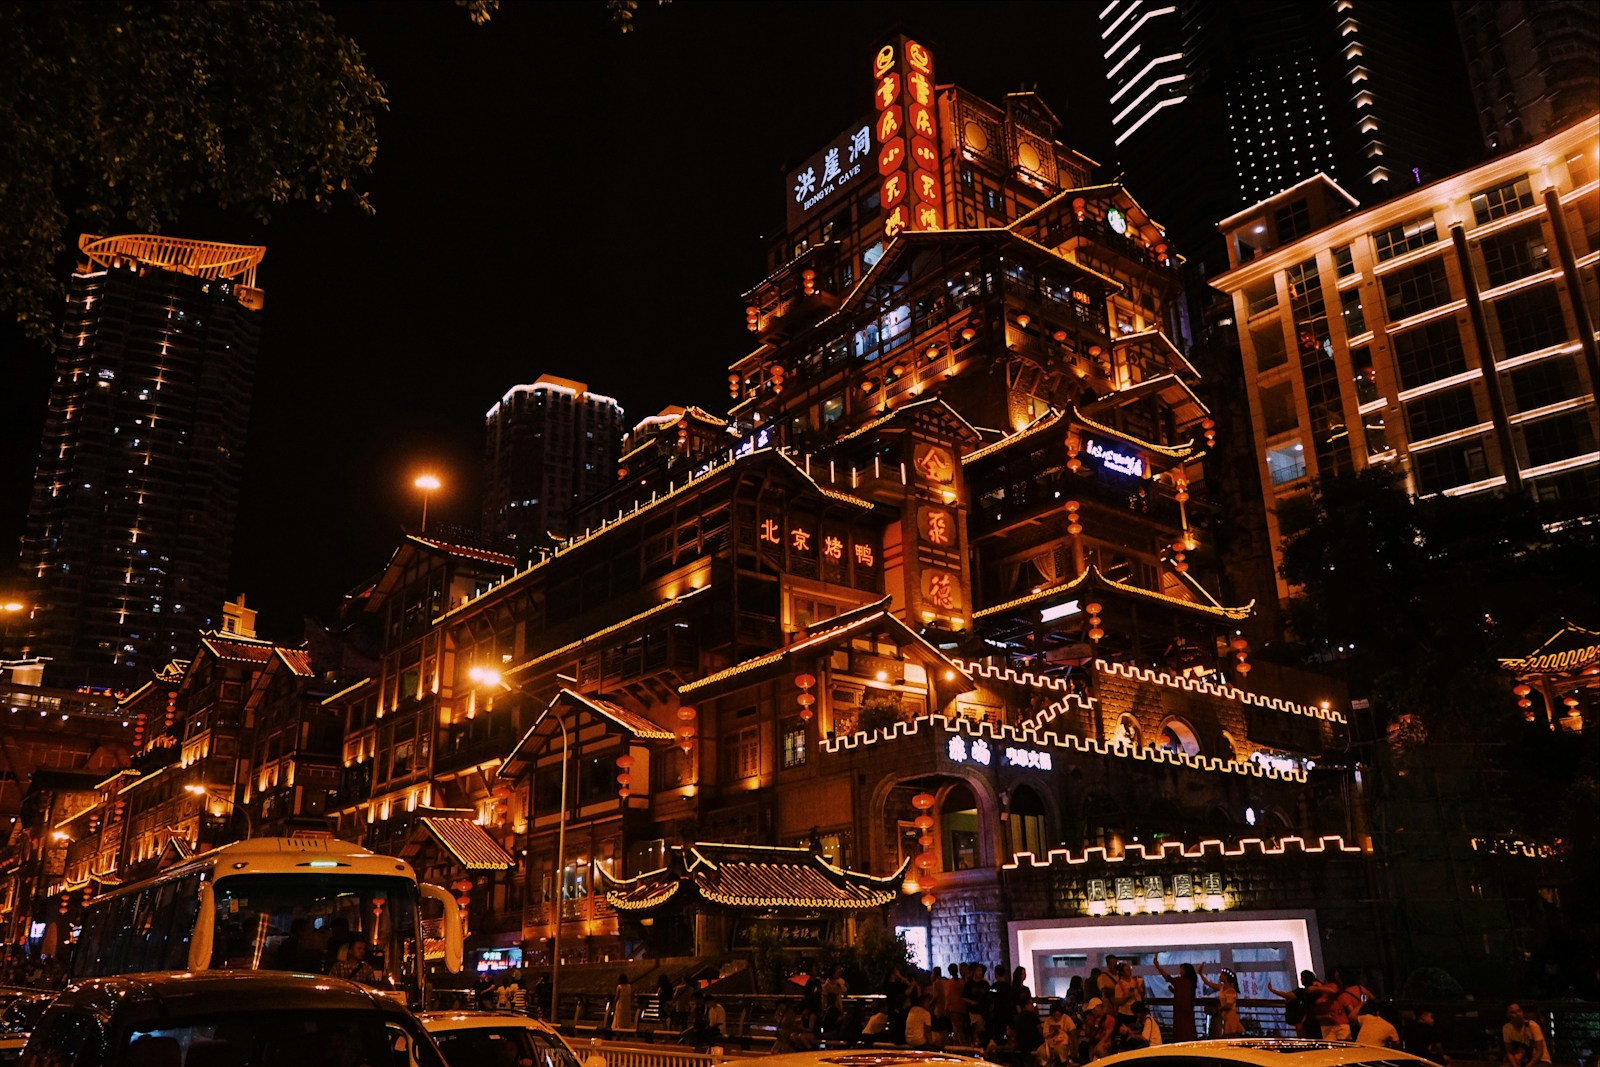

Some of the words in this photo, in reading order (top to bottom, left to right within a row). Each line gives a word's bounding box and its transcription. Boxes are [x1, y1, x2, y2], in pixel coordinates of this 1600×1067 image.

[794, 125, 871, 203] 洪崖洞
[803, 183, 835, 211] HONGYA
[838, 164, 861, 186] CAVE
[760, 518, 875, 568] 北京烤鸭
